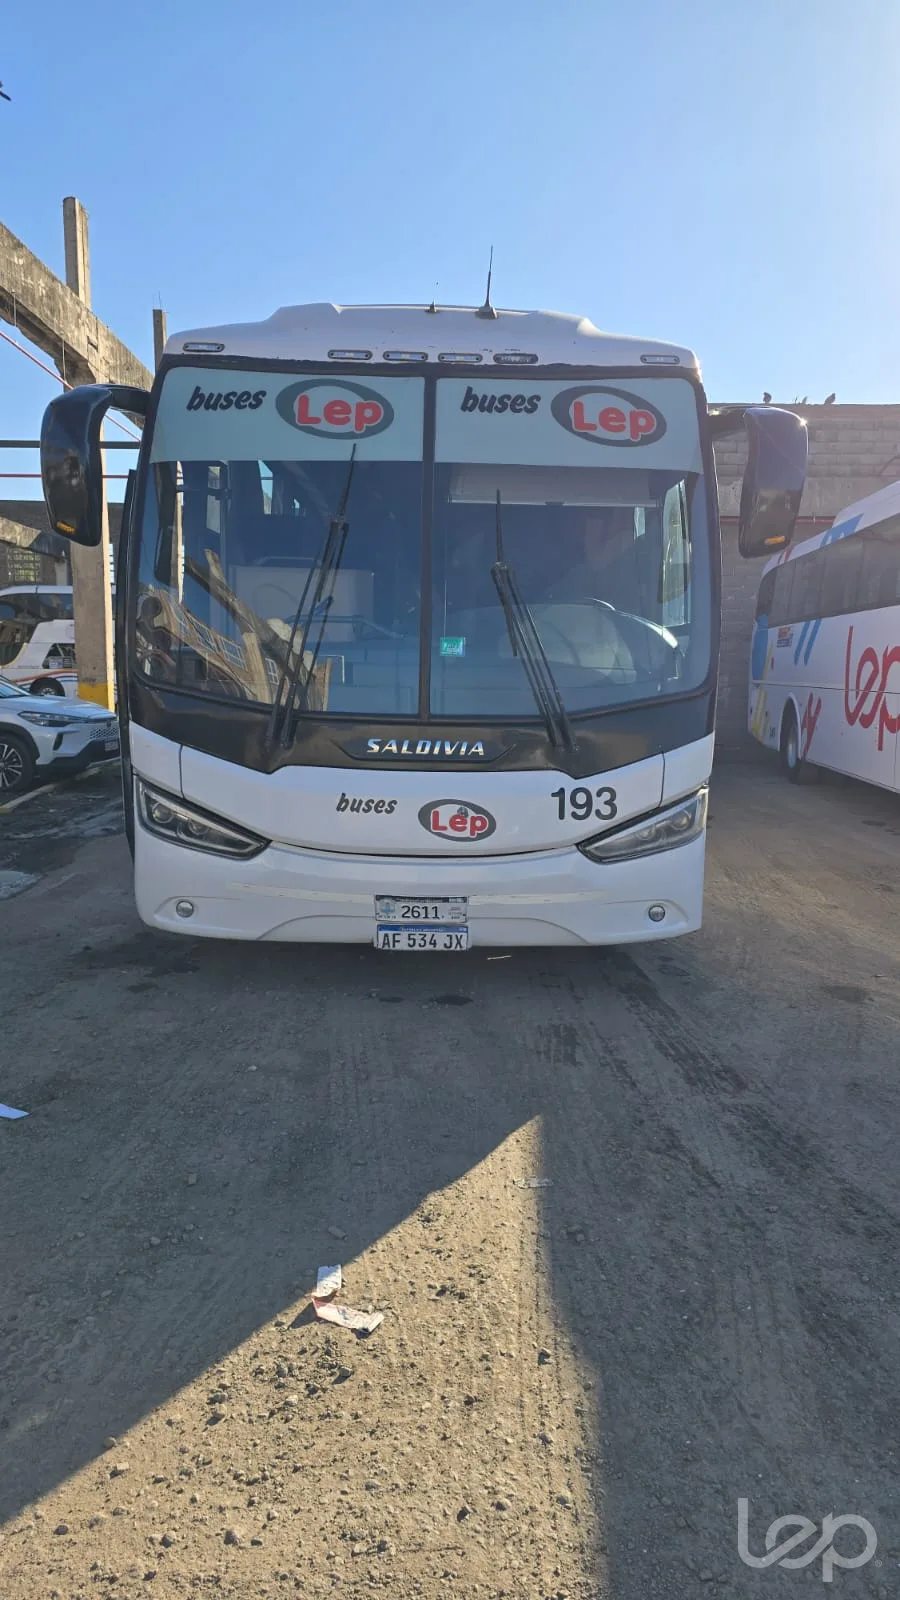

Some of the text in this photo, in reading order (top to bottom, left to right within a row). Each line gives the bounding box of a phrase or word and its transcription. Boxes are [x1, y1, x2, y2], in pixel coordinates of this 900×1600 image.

[186, 385, 383, 433] buses Lep
[460, 386, 656, 441] buses Lep
[366, 738, 485, 756] SALDIVIA
[335, 792, 489, 838] buses Lep
[550, 786, 618, 821] 193
[401, 905, 440, 919] 2611
[381, 933, 464, 949] AF 534 JX
